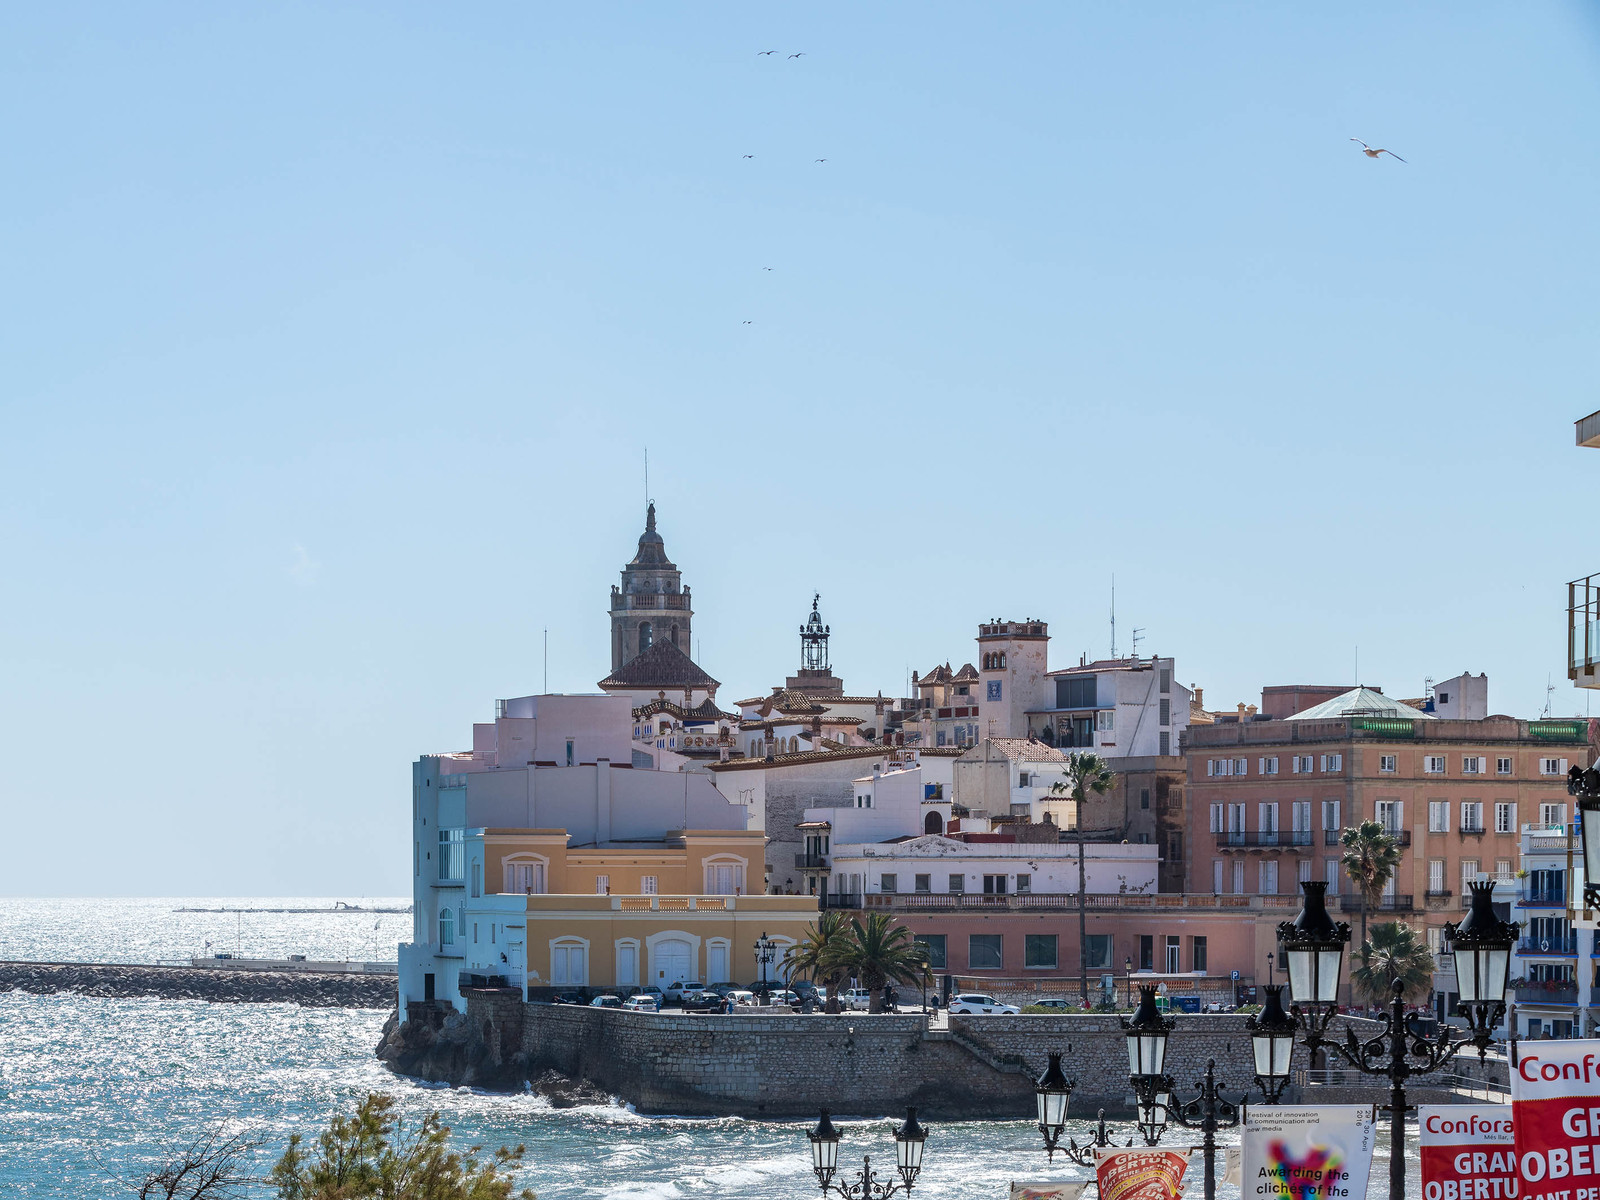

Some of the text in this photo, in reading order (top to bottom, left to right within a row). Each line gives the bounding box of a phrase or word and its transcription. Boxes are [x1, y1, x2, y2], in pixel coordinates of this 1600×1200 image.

[1519, 1054, 1600, 1084] Conf
[1363, 1125, 1370, 1134] 30
[1426, 1115, 1514, 1136] Confora
[1361, 1135, 1369, 1152] April
[1115, 1151, 1167, 1166] GRAN
[1453, 1151, 1517, 1175] GRAN
[1101, 1157, 1181, 1190] OBERTURA
[1258, 1167, 1349, 1181] Awarding the
[1256, 1182, 1349, 1197] clichés of the
